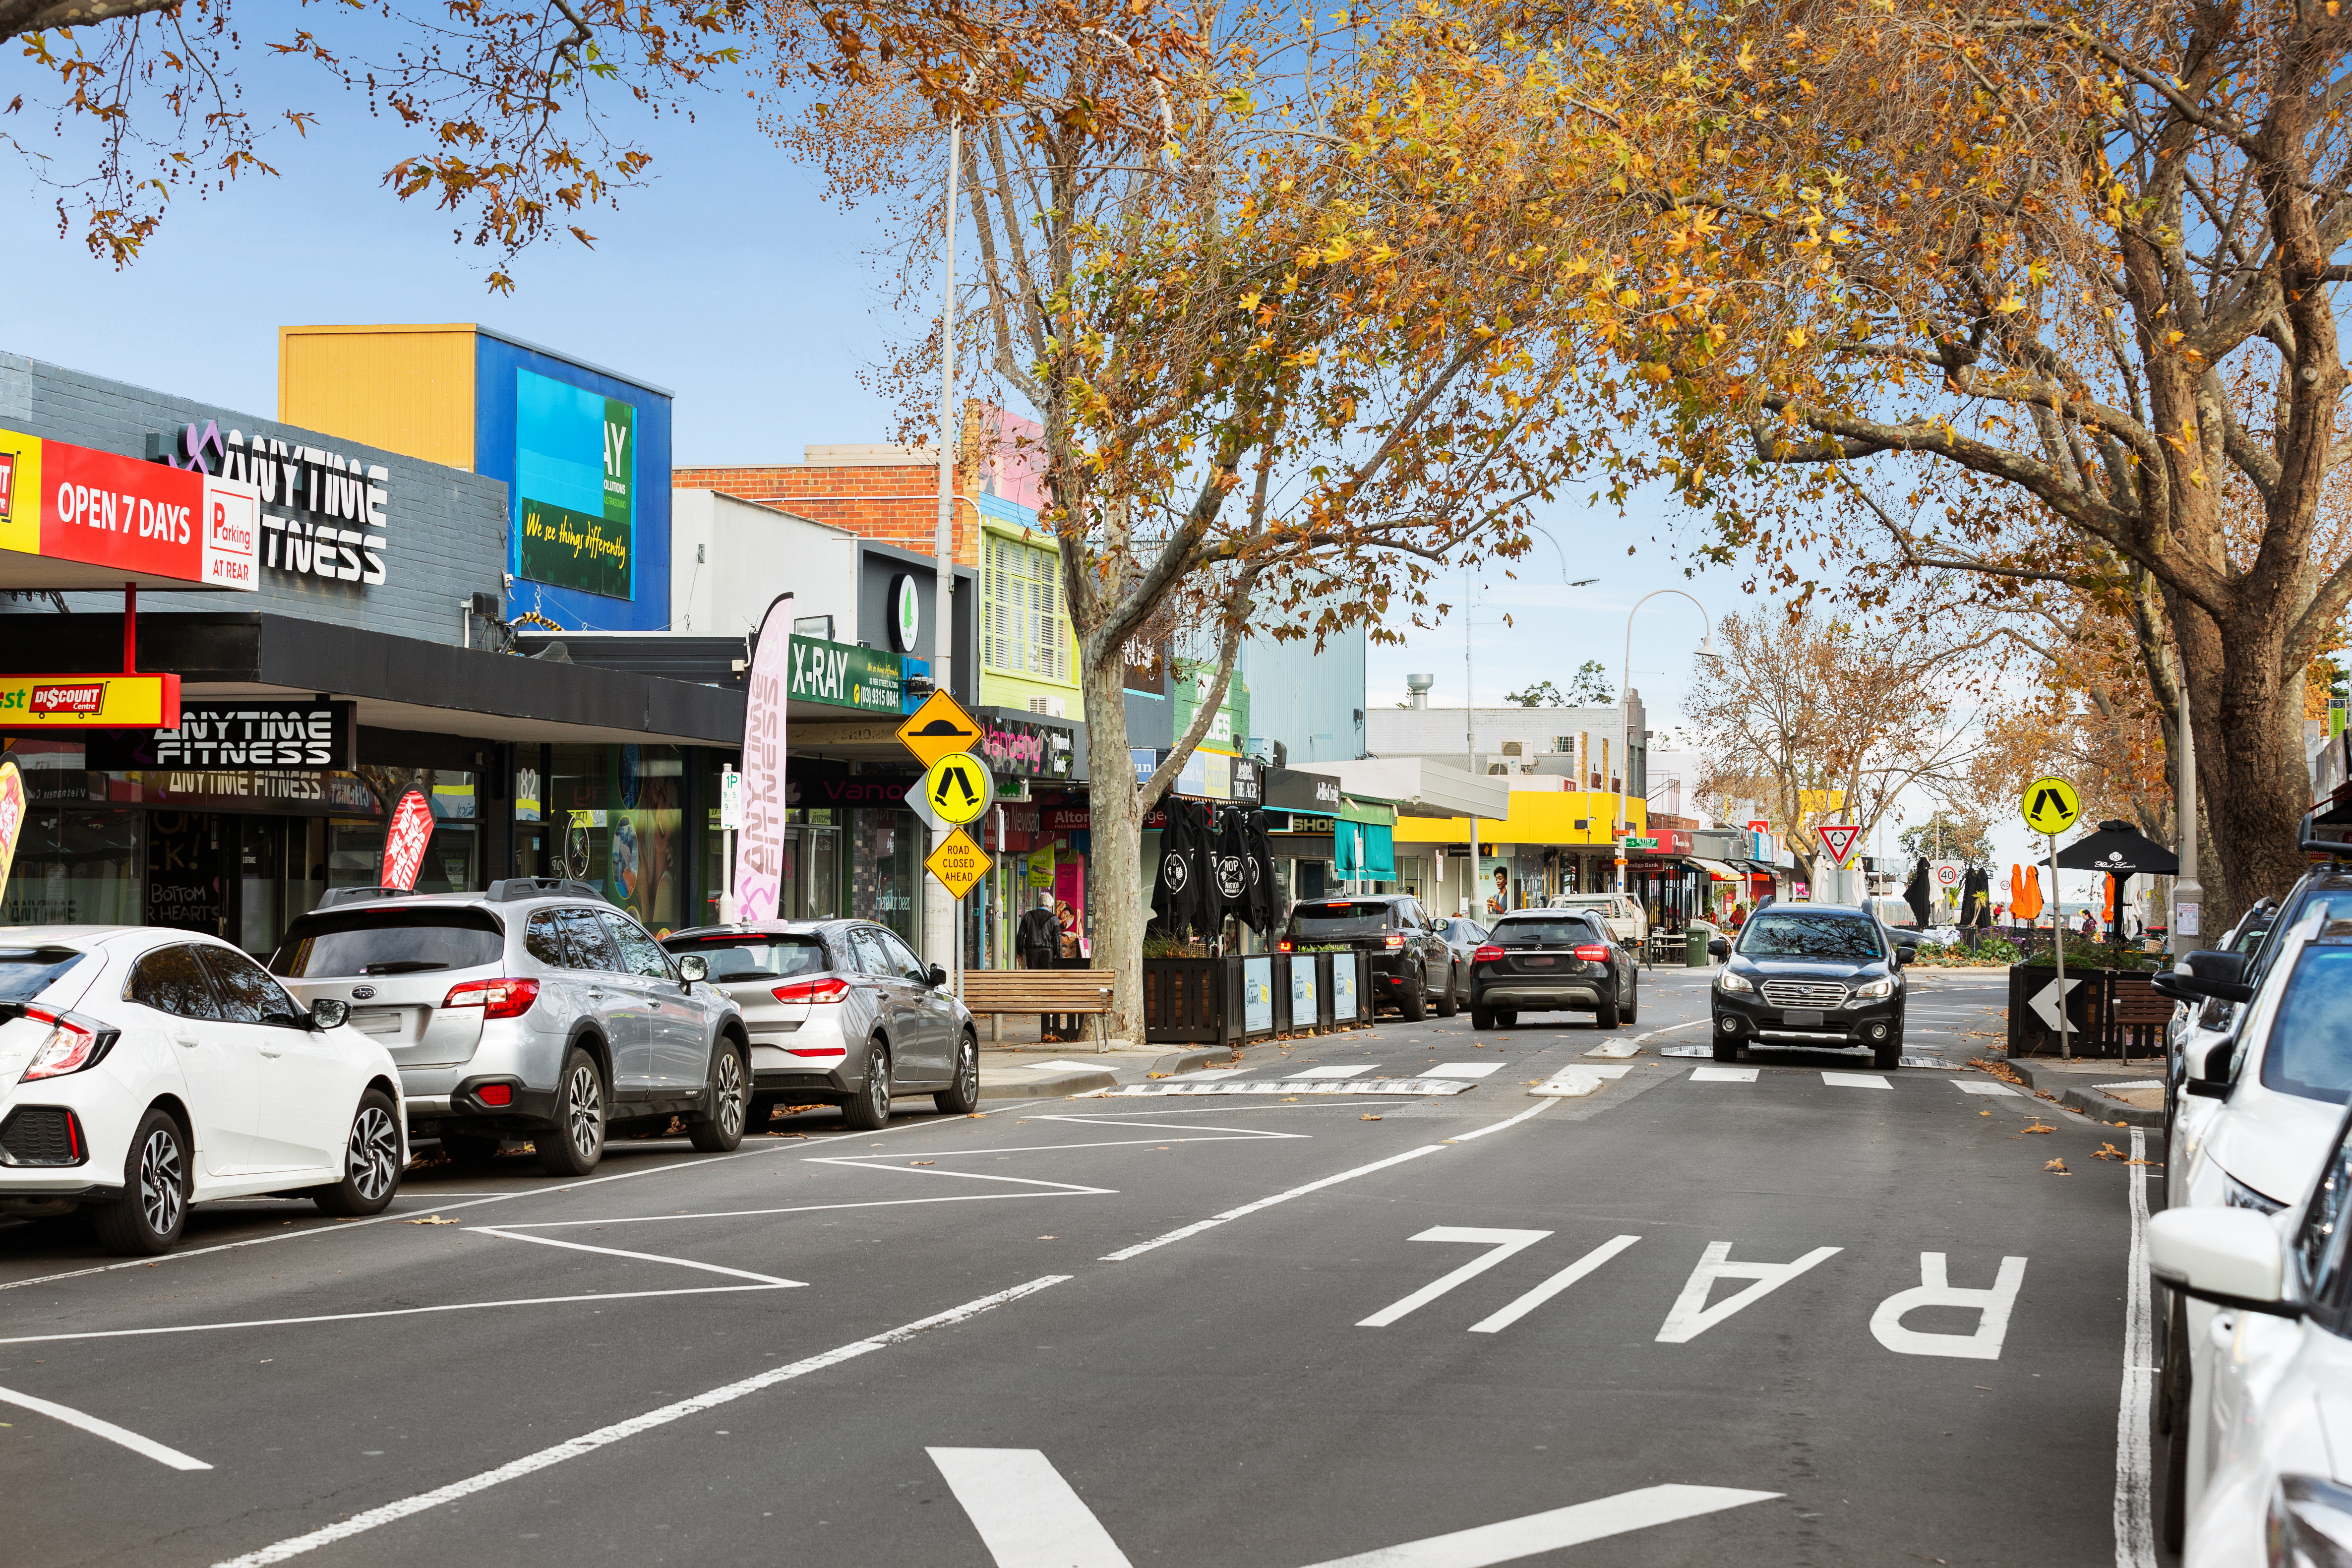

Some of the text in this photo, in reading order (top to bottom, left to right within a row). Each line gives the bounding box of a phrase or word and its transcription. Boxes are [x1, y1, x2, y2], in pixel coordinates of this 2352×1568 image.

[222, 429, 388, 527] ANYTIME
[604, 479, 626, 495] OLUTIONS
[58, 482, 190, 544] OPEN 7 DAYS
[604, 496, 626, 509] ULTRASOUND
[214, 501, 250, 550] Parking
[262, 514, 386, 586] TNESS
[526, 512, 625, 570] We see things differently
[213, 559, 248, 581] AT REAR
[792, 643, 848, 700] X-RAY
[867, 662, 872, 671] We
[885, 663, 899, 681] differently
[879, 679, 889, 688] STREET,
[861, 686, 899, 708] (03) 9315 0841
[154, 711, 331, 739] ANYTIME
[983, 723, 1041, 773] Vanoshy
[1052, 732, 1070, 750] Preloved
[157, 741, 331, 764] FITNESS
[744, 672, 764, 875] ANYTIME
[1054, 755, 1066, 773] Goods
[1134, 763, 1152, 773] un
[1196, 763, 1204, 782] Sun
[169, 770, 321, 799] ANYTIME FITNESS
[521, 768, 536, 800] 82
[727, 776, 737, 788] 1P
[762, 675, 779, 877] FITNESS
[1207, 760, 1228, 795] Sunday
[1234, 782, 1257, 798] THE AGE
[984, 805, 1046, 839] Alta Newsag
[1055, 810, 1090, 823] Alton
[948, 845, 969, 854] ROAD
[943, 859, 974, 868] CLOSED
[1225, 860, 1238, 871] HOP
[945, 872, 972, 881] AHEAD
[1941, 871, 1953, 879] 40
[876, 889, 889, 910] Here
[10, 900, 76, 922] ANYTIME
[1354, 1225, 2028, 1360] RAIL
